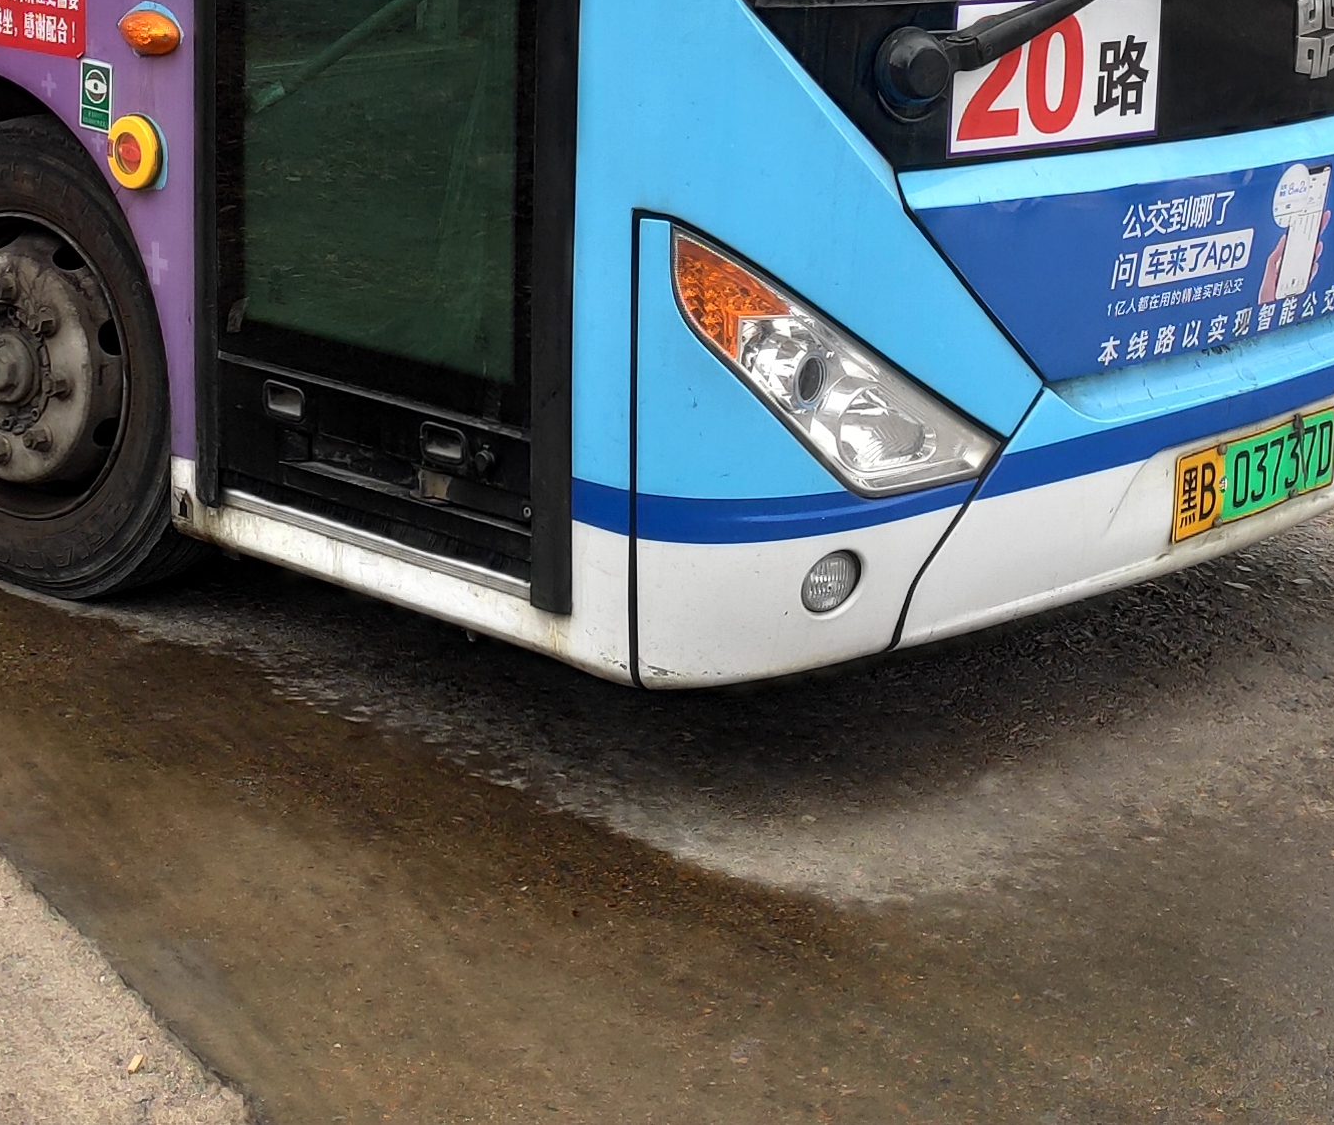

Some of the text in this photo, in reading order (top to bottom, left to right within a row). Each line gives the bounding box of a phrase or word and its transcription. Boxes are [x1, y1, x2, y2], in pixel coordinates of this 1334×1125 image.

[1122, 191, 1235, 240] 公交到哪了
[1110, 251, 1139, 290] 问
